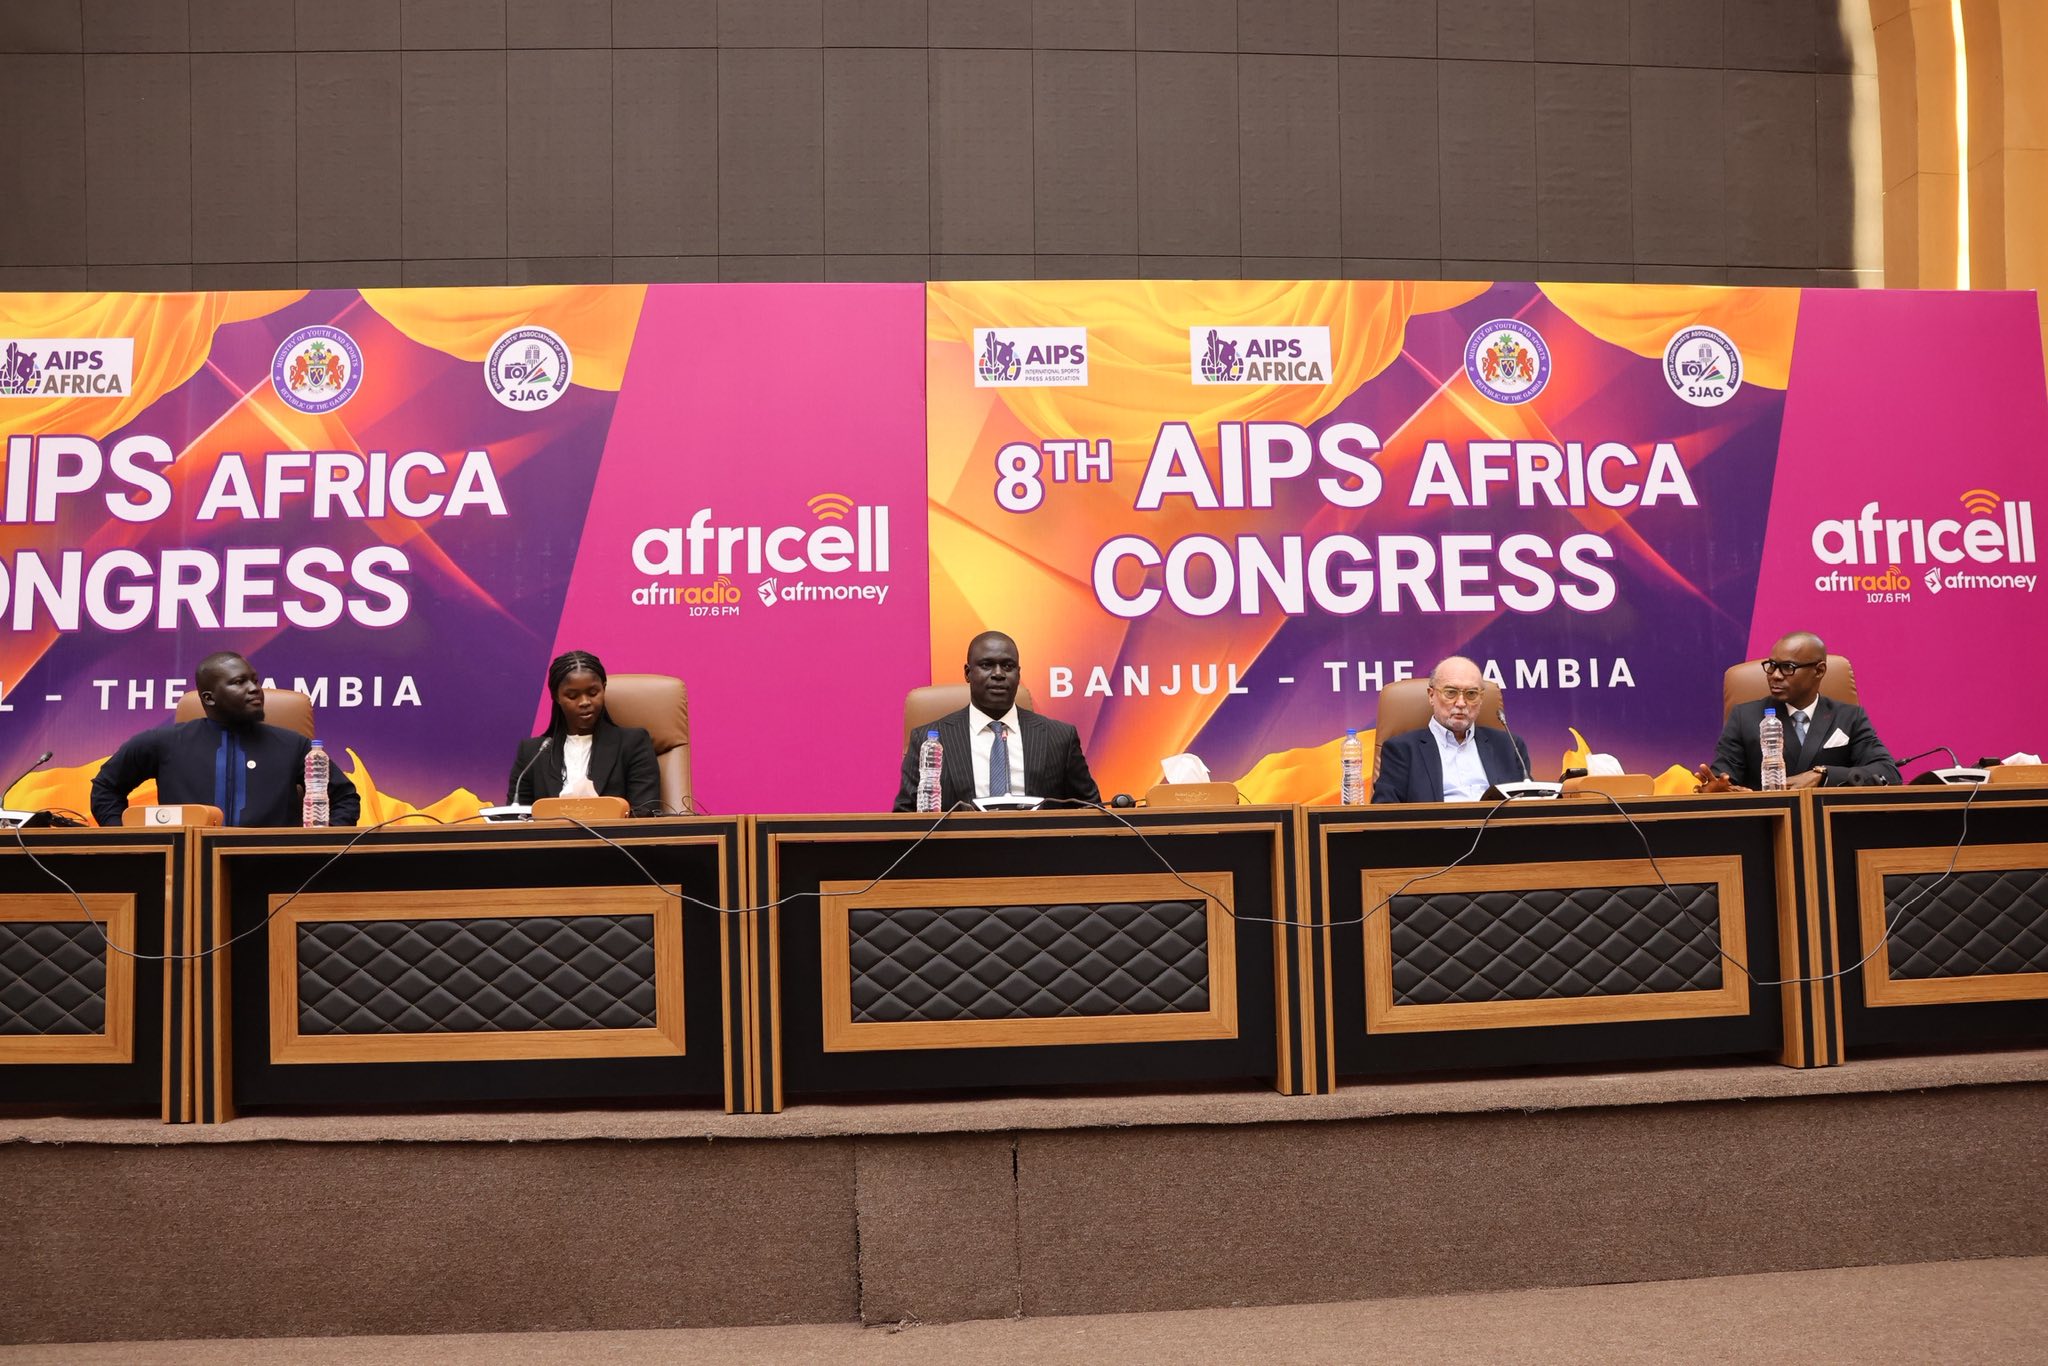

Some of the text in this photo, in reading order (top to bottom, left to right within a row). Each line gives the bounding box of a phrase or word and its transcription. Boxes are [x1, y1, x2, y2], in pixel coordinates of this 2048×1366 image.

[276, 330, 359, 368] MINISTRY OF YOUTH AND SPORTS
[553, 342, 561, 352] OF
[558, 352, 566, 364] THE
[1245, 339, 1302, 358] AIPS
[1468, 330, 1486, 360] MINISTRY
[1484, 325, 1494, 335] OF
[1518, 325, 1531, 338] AND
[1530, 335, 1546, 361] SPORTS
[44, 350, 104, 370] AIPS
[1025, 344, 1085, 365] AIPS
[1729, 351, 1737, 362] THE
[1246, 361, 1324, 381] AFRICA
[42, 374, 122, 394] AFRICA
[1688, 386, 1724, 398] SJAG
[509, 389, 549, 402] SJAG
[1501, 394, 1510, 402] OF
[1511, 393, 1523, 402] THE
[996, 422, 1699, 511] 8TH AIPS AFRICA
[5, 435, 508, 523] IPS AFRICA
[631, 505, 890, 575] africell
[1811, 500, 2037, 565] africell
[1093, 533, 1617, 617] CONGRESS
[1815, 570, 2037, 593] afriradio afrimoney
[0, 545, 410, 633] NGRESS
[631, 581, 889, 605] afriradio afrimoney
[1866, 593, 1911, 604] 107.6 FM
[689, 606, 740, 617] 107.6 FM
[1050, 663, 1249, 698] BANJUL
[1482, 657, 1636, 689] AMBIA
[93, 678, 187, 711] THE
[261, 675, 422, 708] MBIA
